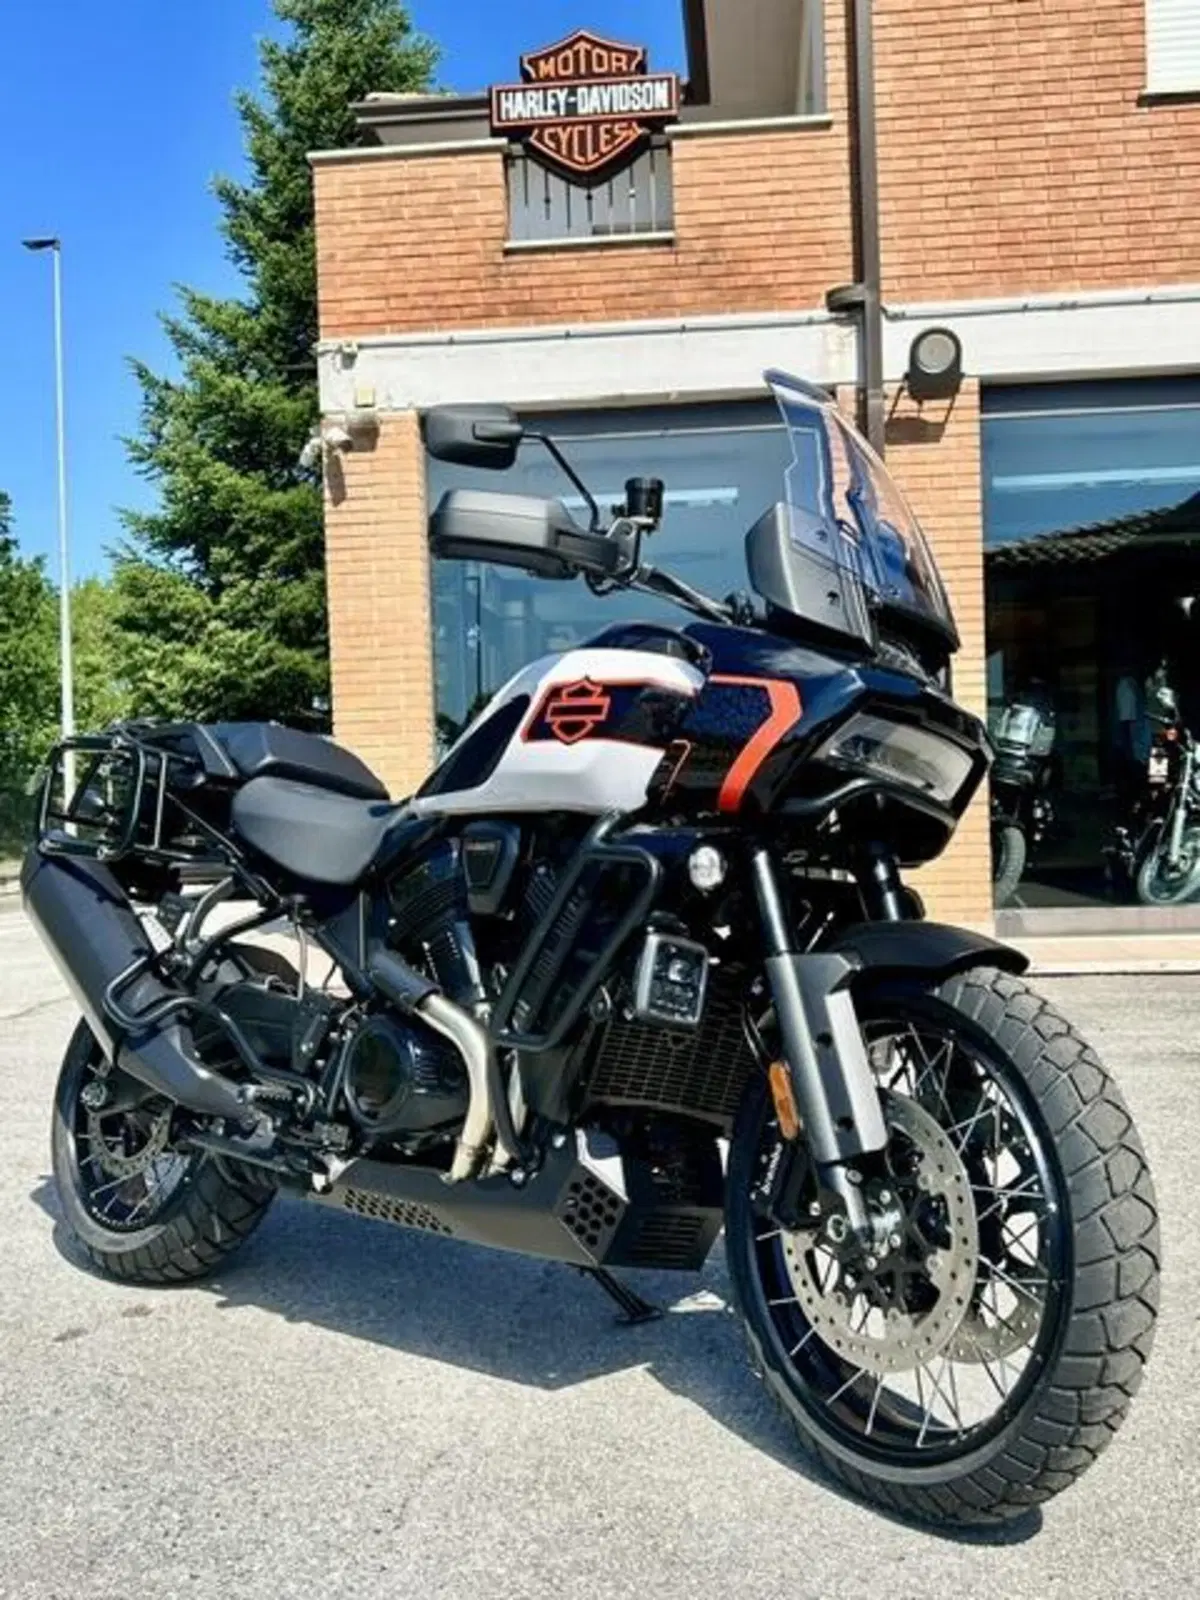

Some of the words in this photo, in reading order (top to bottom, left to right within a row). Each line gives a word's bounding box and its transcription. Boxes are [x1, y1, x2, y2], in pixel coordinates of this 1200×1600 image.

[538, 40, 627, 79] MOTOR
[500, 79, 669, 121] HARLEY-DAVIDSON
[543, 122, 635, 164] CYCLES
